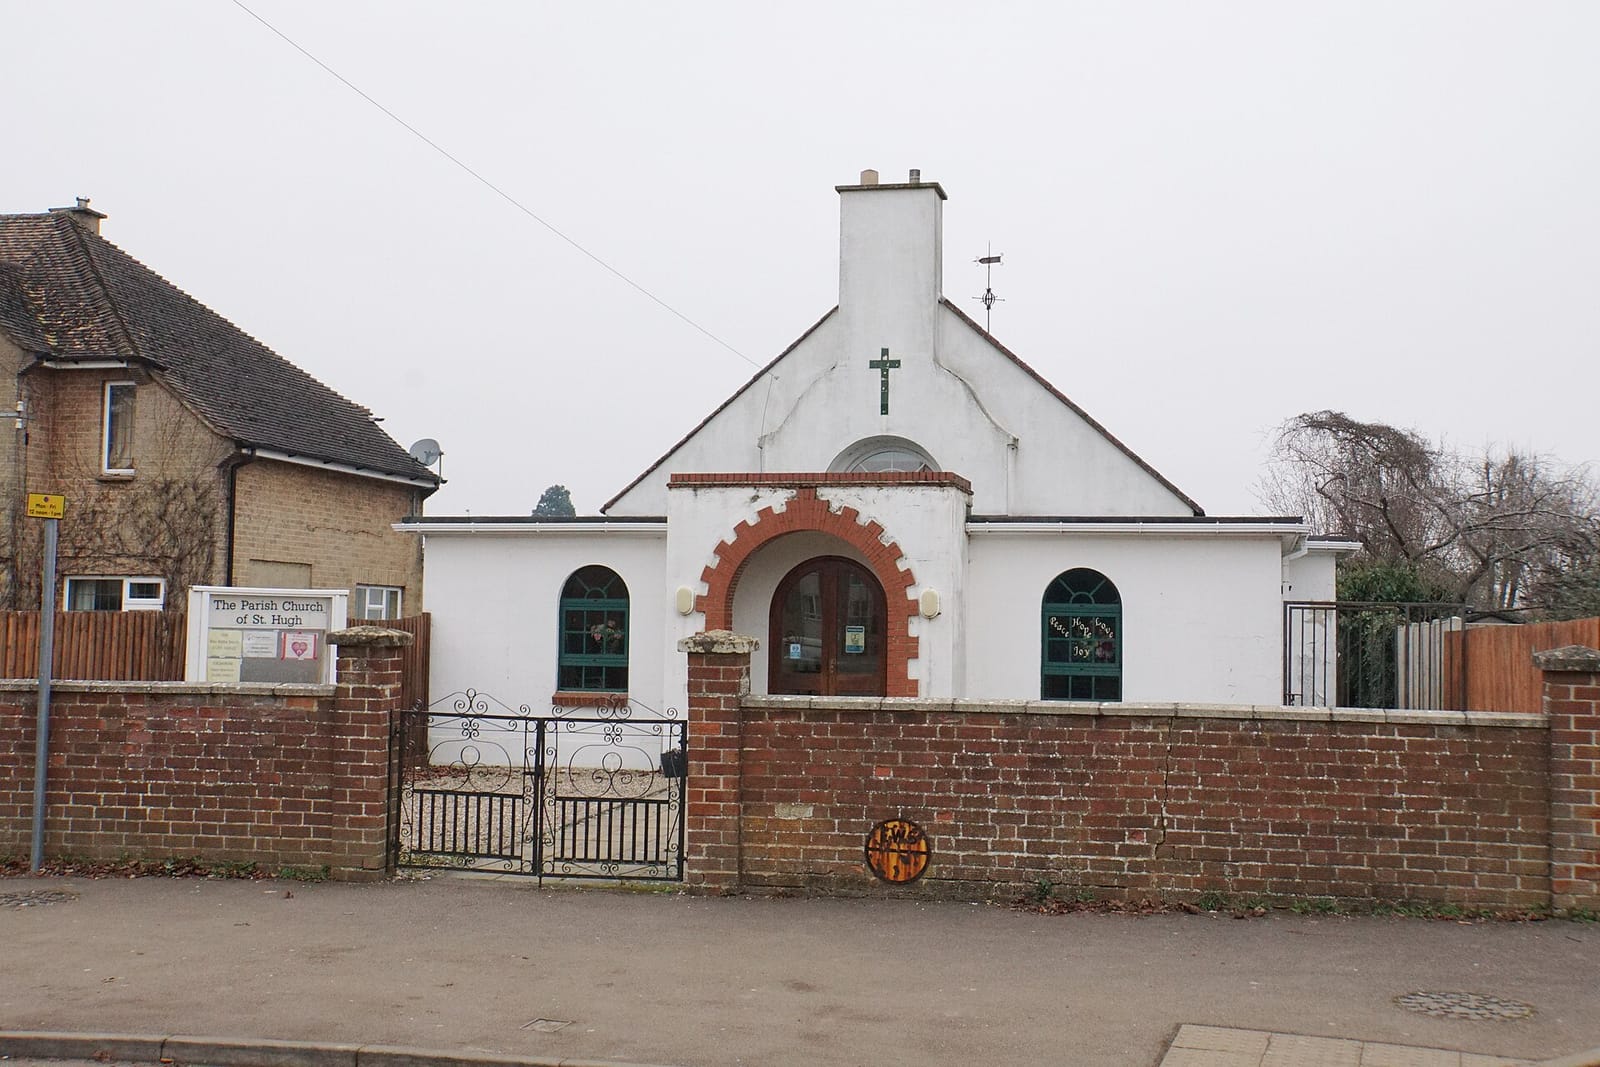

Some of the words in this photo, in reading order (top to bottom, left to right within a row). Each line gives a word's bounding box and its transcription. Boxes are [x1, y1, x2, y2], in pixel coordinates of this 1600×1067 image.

[214, 599, 237, 610] The
[241, 600, 278, 611] Parish
[282, 601, 324, 612] Church
[236, 614, 248, 625] of
[252, 614, 267, 625] St.
[271, 615, 303, 627] Hugh
[1049, 616, 1070, 638] Peace
[1071, 616, 1093, 638] Hope
[1095, 617, 1114, 639] Love
[1073, 646, 1090, 658] Joy
